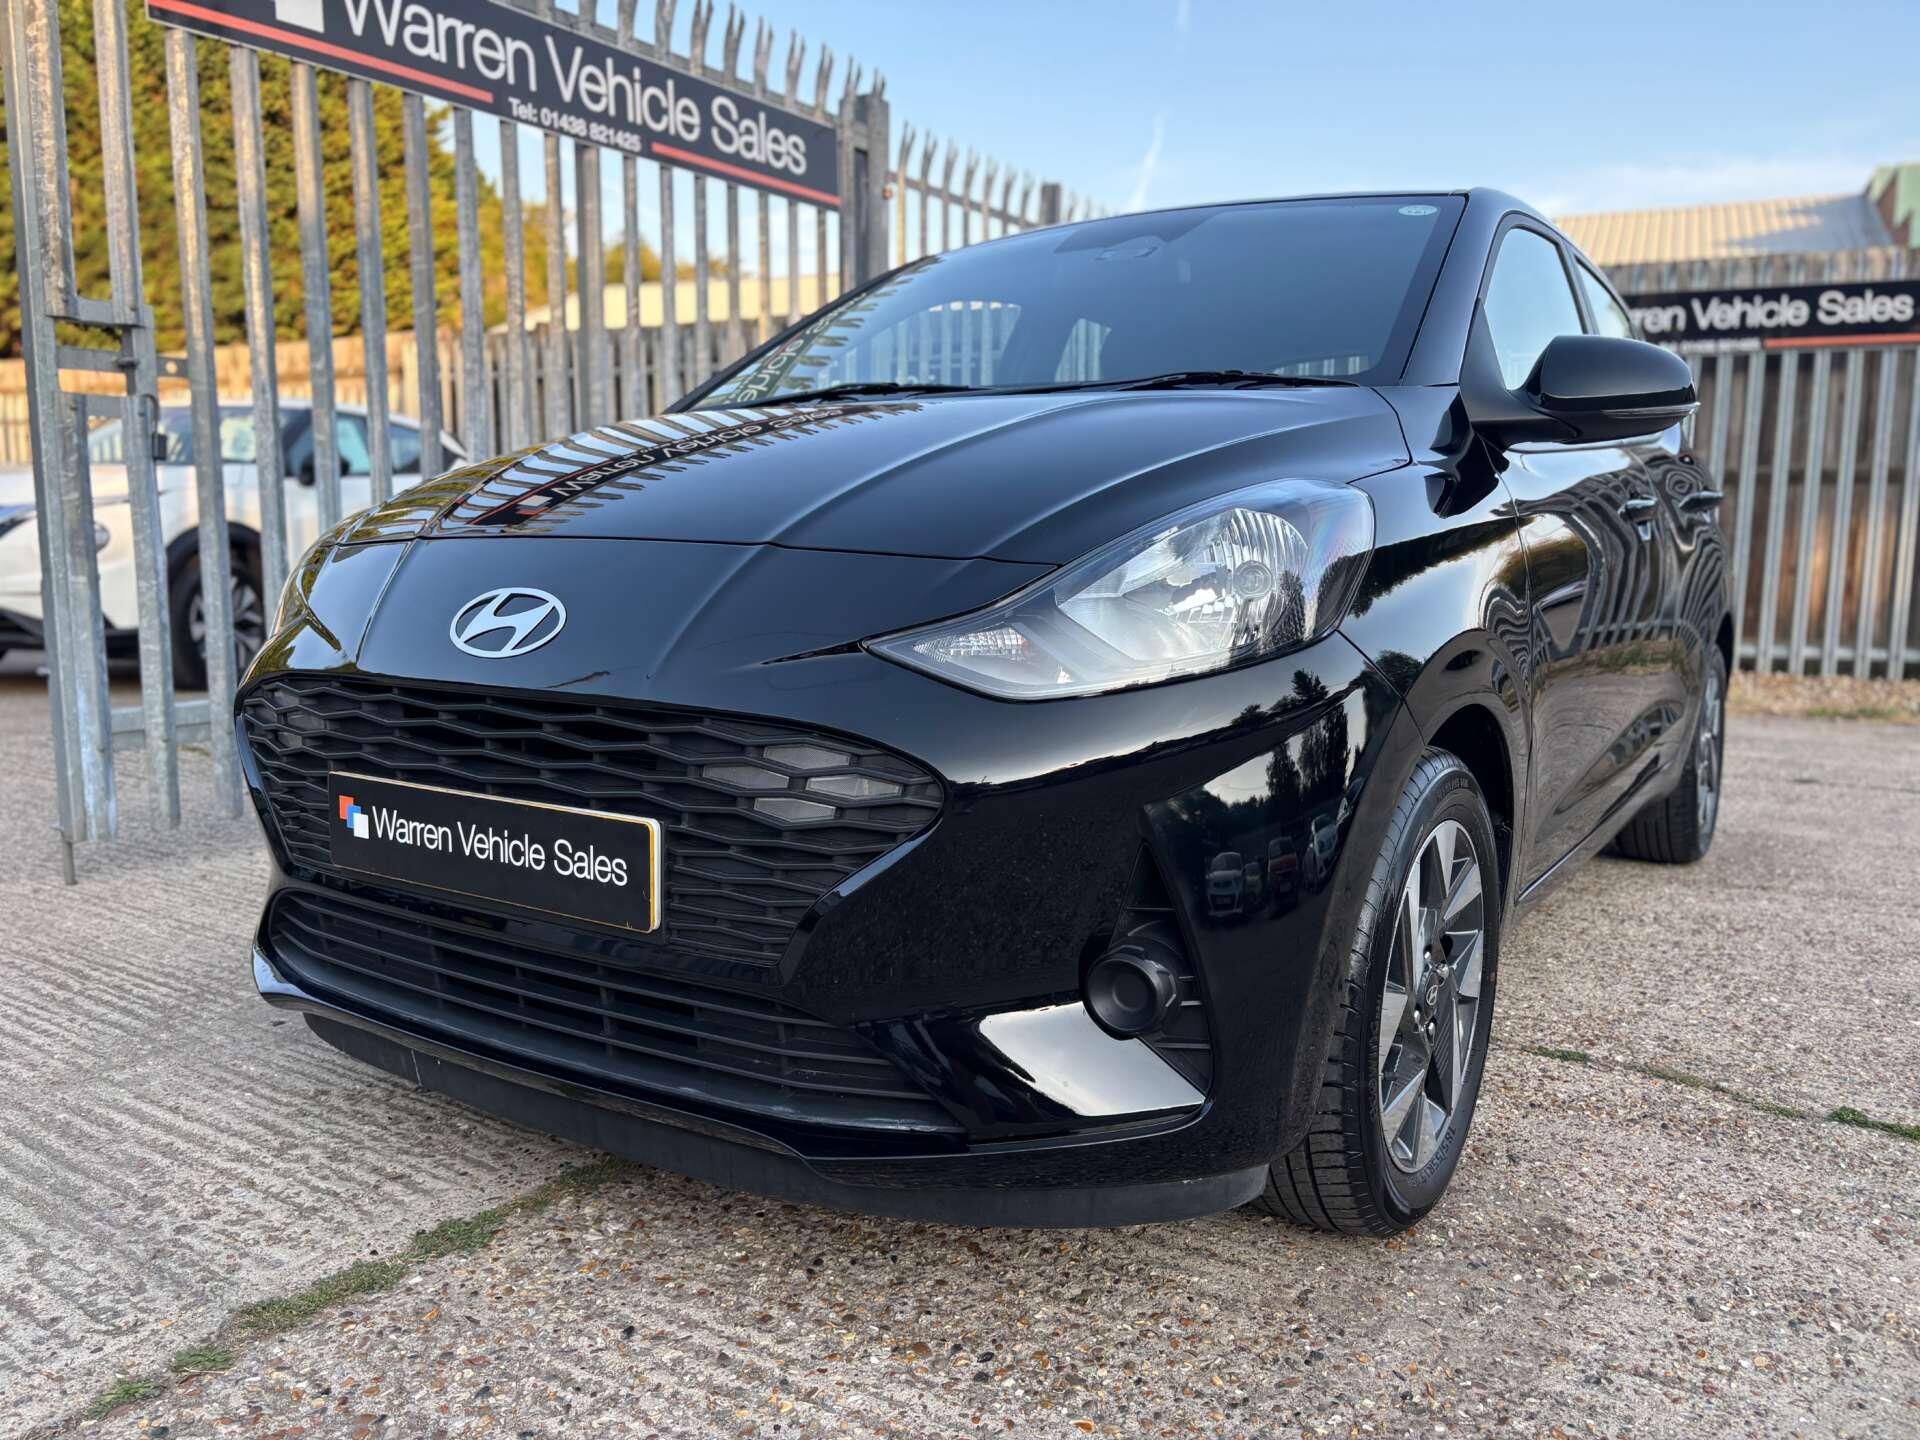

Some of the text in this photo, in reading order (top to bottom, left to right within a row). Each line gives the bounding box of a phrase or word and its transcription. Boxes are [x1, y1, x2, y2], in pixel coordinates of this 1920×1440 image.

[344, 0, 808, 176] Warren Vehicle Sales
[507, 97, 642, 153] Tel: 01438 821425
[1690, 293, 1810, 331] Vehicle
[1816, 288, 1915, 326] Sales
[372, 805, 629, 887] Warren Vehicle Sales
